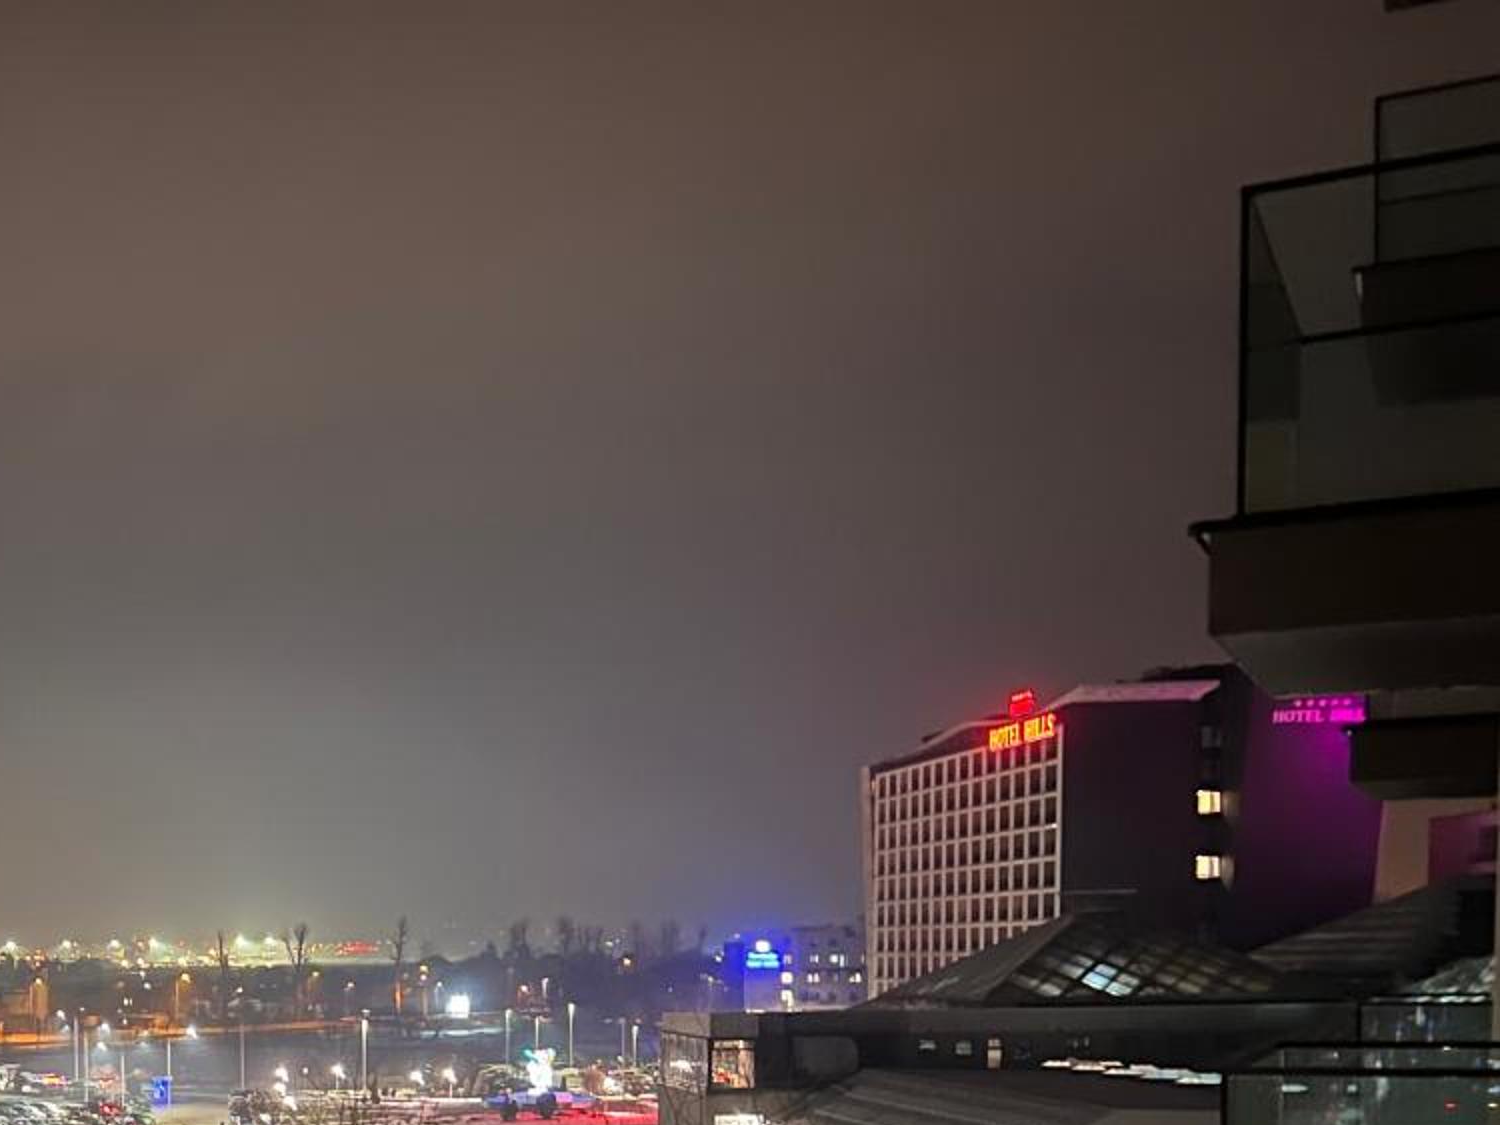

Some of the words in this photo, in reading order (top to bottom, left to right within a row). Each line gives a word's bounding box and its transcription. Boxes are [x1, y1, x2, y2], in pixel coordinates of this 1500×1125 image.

[1273, 709, 1323, 723] HOTEL
[989, 722, 1021, 752] HOTEL
[1023, 713, 1056, 743] HILLS
